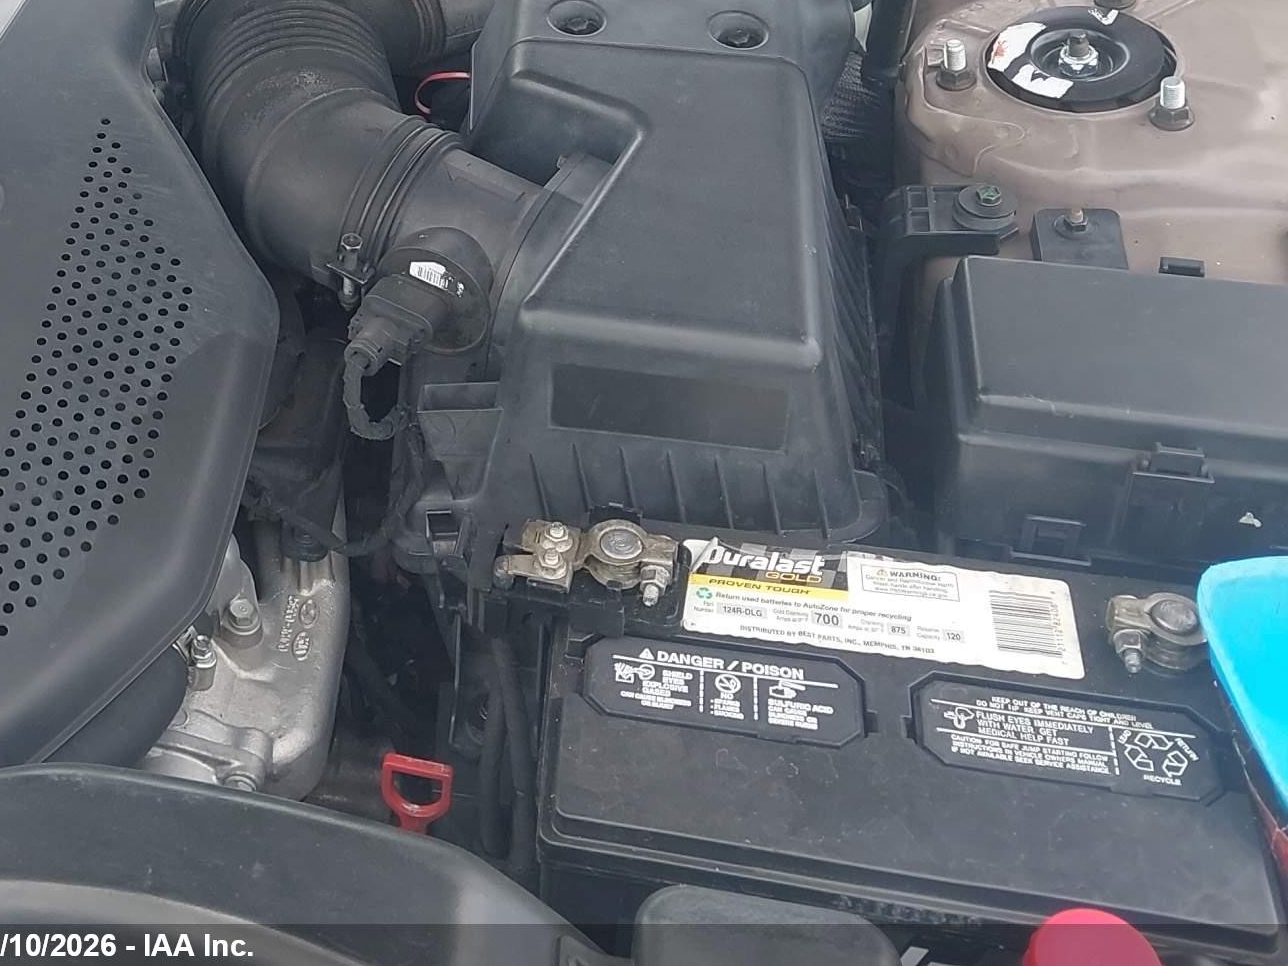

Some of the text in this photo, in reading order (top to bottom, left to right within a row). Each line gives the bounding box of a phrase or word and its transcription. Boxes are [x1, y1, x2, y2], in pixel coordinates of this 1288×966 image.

[707, 544, 825, 576] Duralast
[765, 571, 823, 584] GOLD
[709, 578, 812, 595] PROVEN TOUGH
[715, 592, 741, 601] Return
[742, 595, 760, 603] used
[760, 597, 794, 607] batteries
[803, 601, 839, 612] AutoZone
[852, 609, 876, 618] proper
[878, 612, 913, 622] recycling
[722, 605, 763, 617] 124R-DLG
[814, 612, 840, 626] 700
[739, 624, 786, 636] DISTRIBUTED
[798, 630, 817, 639] BEST
[891, 625, 907, 635] 875
[946, 632, 962, 642] 120
[657, 650, 725, 670] DANGER
[741, 661, 805, 681] POISON
[662, 670, 693, 680] SHIELD
[642, 680, 689, 693] EXPLOSIVE
[642, 686, 672, 697] GASES
[767, 698, 834, 714] SULFURIC ACID
[976, 699, 988, 707] DO
[989, 701, 1005, 710] NOT
[1023, 707, 1043, 715] KEEP
[1045, 709, 1065, 718] VENT
[1066, 712, 1088, 721] CAPS
[1089, 715, 1112, 724] TIGHT
[1131, 721, 1154, 729] LEVEL
[992, 696, 1011, 704] KEEP
[1012, 698, 1028, 707] OUT
[1043, 703, 1058, 711] THE
[1060, 705, 1086, 714] REACH
[1099, 710, 1137, 722] CHILDREN
[976, 710, 1094, 734] FLUSH EYES IMMEDIATELY
[977, 719, 1001, 729] WITH
[1039, 727, 1058, 737] GET
[977, 726, 1070, 746] MEDICAL HELP FAST
[951, 745, 959, 753] IF
[959, 747, 975, 755] NOT
[976, 750, 1014, 762] AVAILABLE
[1014, 756, 1034, 765] SEEK
[1034, 759, 1065, 769] SERVICE
[952, 740, 1004, 754] INSTRUCTIONS
[1004, 748, 1014, 756] IN
[1014, 750, 1043, 760] VEHICLE
[984, 739, 1000, 747] FOR
[1001, 742, 1020, 750] SAFE
[1021, 745, 1041, 753] JUMP
[1042, 747, 1078, 758] STARTING
[1078, 752, 1109, 762] FOLLOW
[1174, 737, 1200, 762] RETURN
[1143, 774, 1182, 786] RECYCLE
